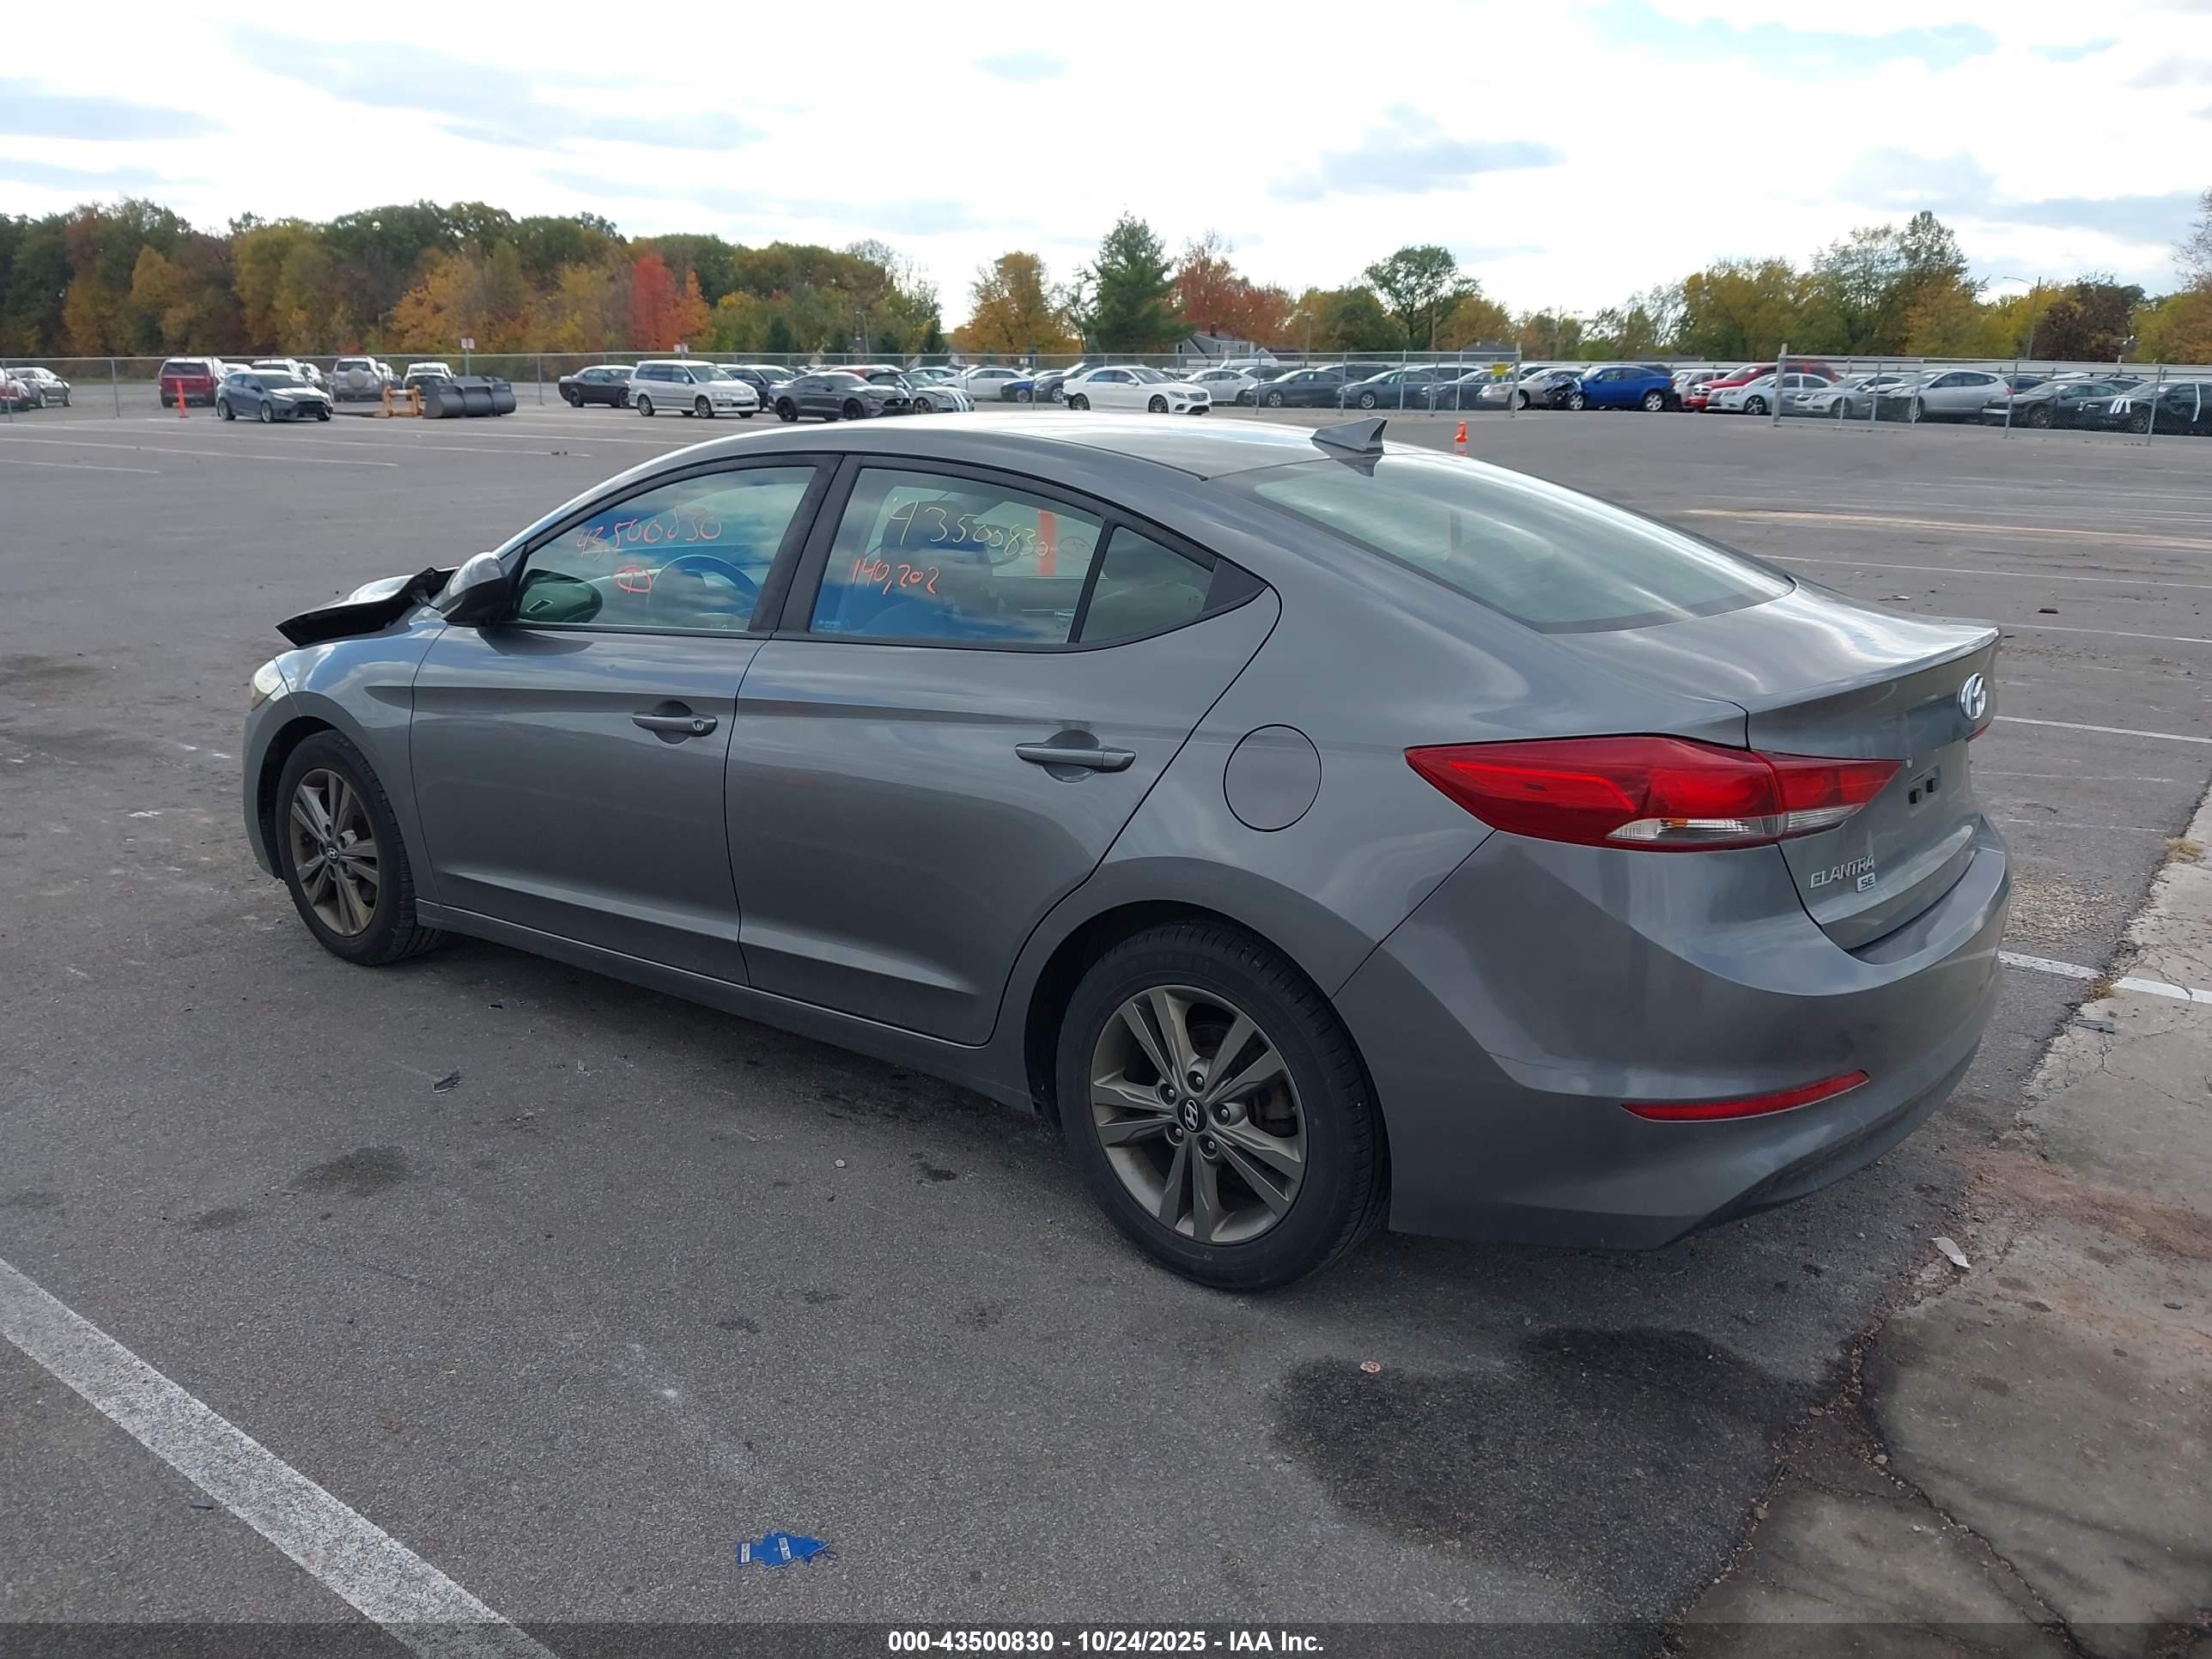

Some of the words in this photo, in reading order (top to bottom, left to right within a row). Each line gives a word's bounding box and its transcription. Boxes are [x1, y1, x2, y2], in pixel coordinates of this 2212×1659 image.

[890, 496, 1050, 557] 43500830
[852, 558, 940, 595] 140,202
[1809, 854, 1875, 889] ELANTRA
[1860, 875, 1875, 890] SE
